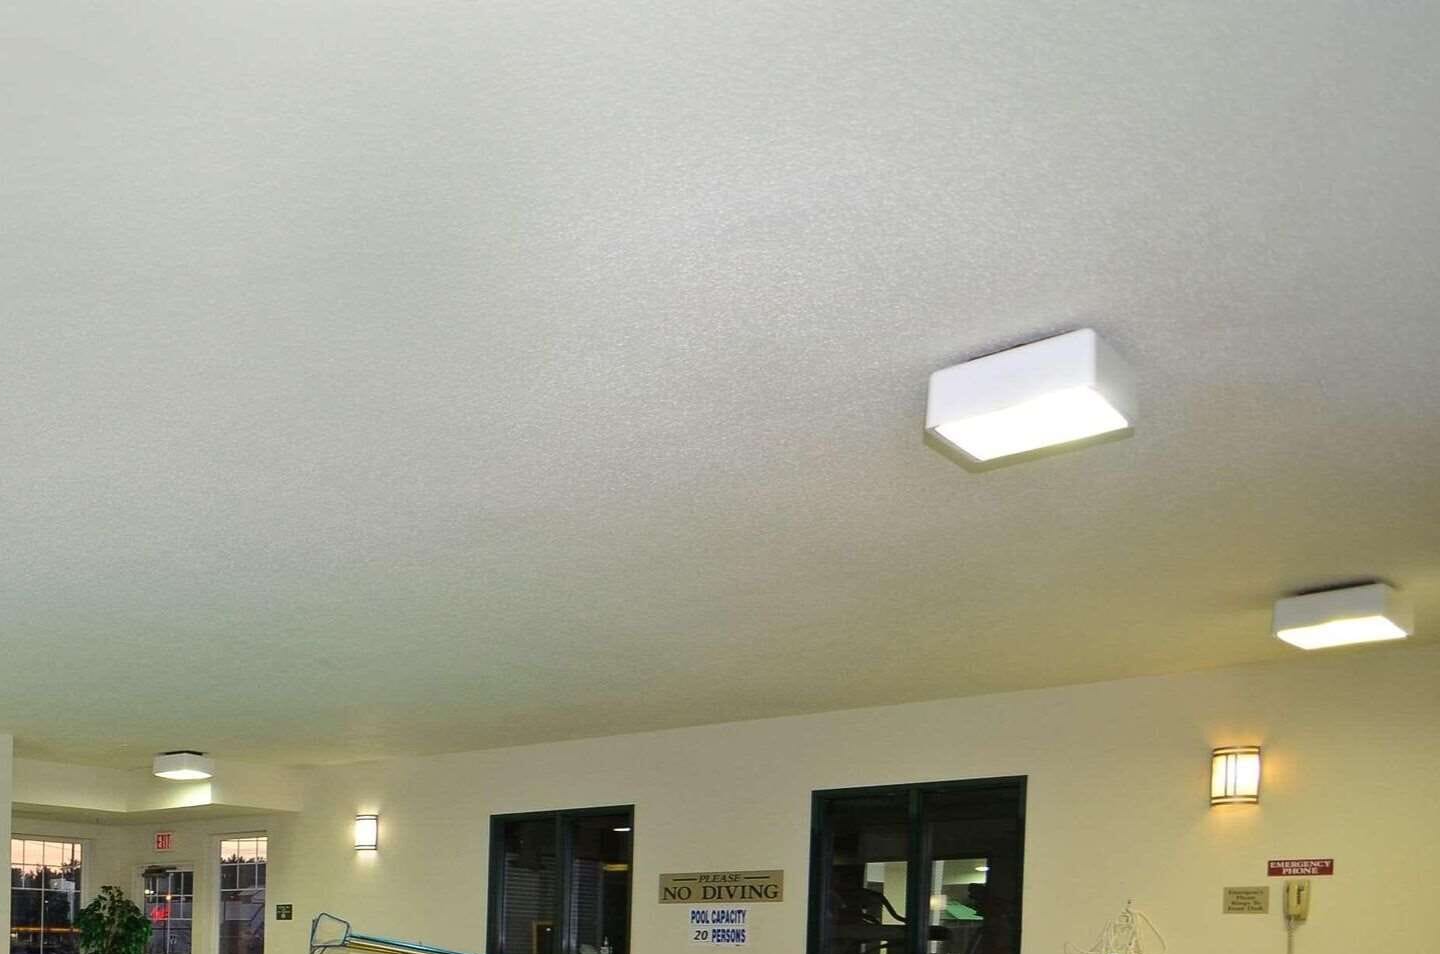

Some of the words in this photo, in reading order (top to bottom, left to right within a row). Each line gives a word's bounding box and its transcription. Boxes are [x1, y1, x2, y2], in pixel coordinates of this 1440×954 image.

[698, 874, 742, 883] PLEASE
[663, 886, 692, 901] NO
[702, 884, 779, 900] DIVING
[690, 910, 709, 924] POOL
[711, 909, 747, 924] CAPACITY
[694, 930, 708, 941] 20
[711, 928, 746, 943] PERSONS
